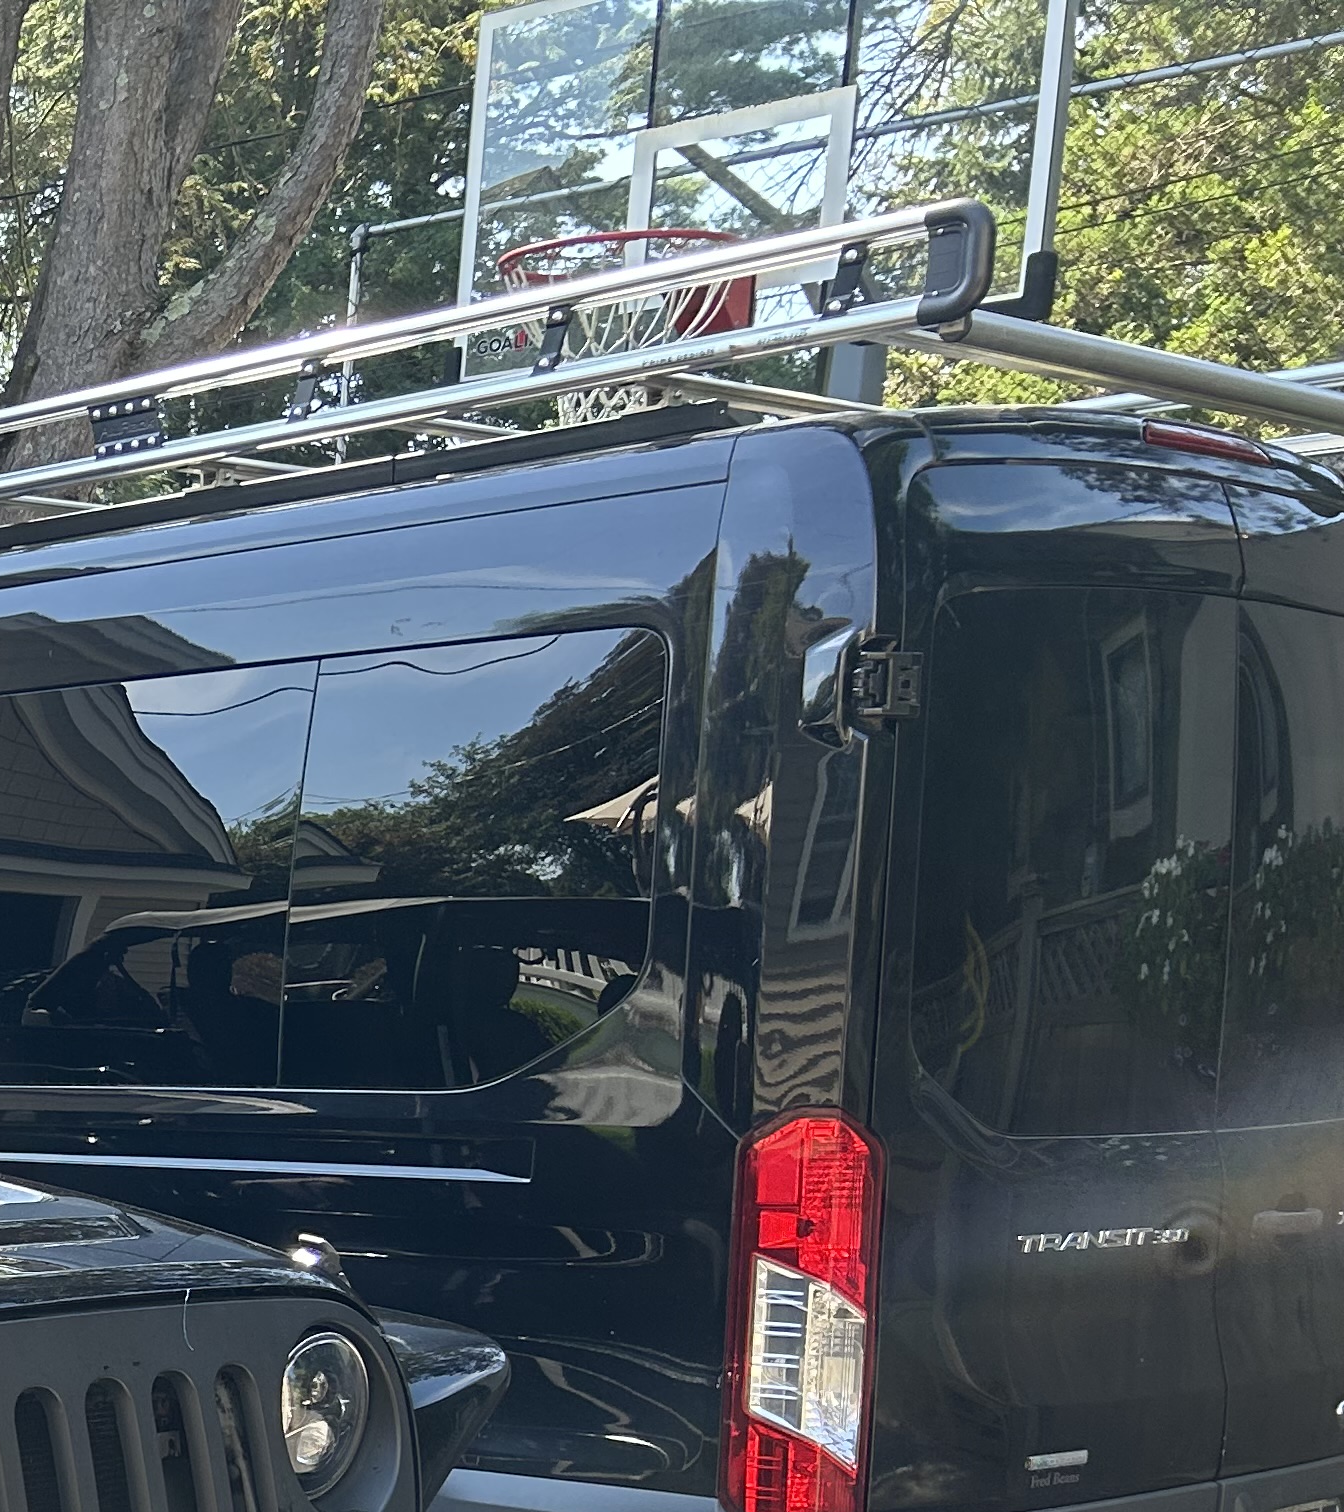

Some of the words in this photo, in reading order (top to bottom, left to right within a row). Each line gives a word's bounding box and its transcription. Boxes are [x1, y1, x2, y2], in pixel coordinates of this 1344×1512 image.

[1017, 1228, 1152, 1253] TRANSIT
[1030, 1473, 1052, 1489] Fred
[1053, 1472, 1080, 1485] Beans
